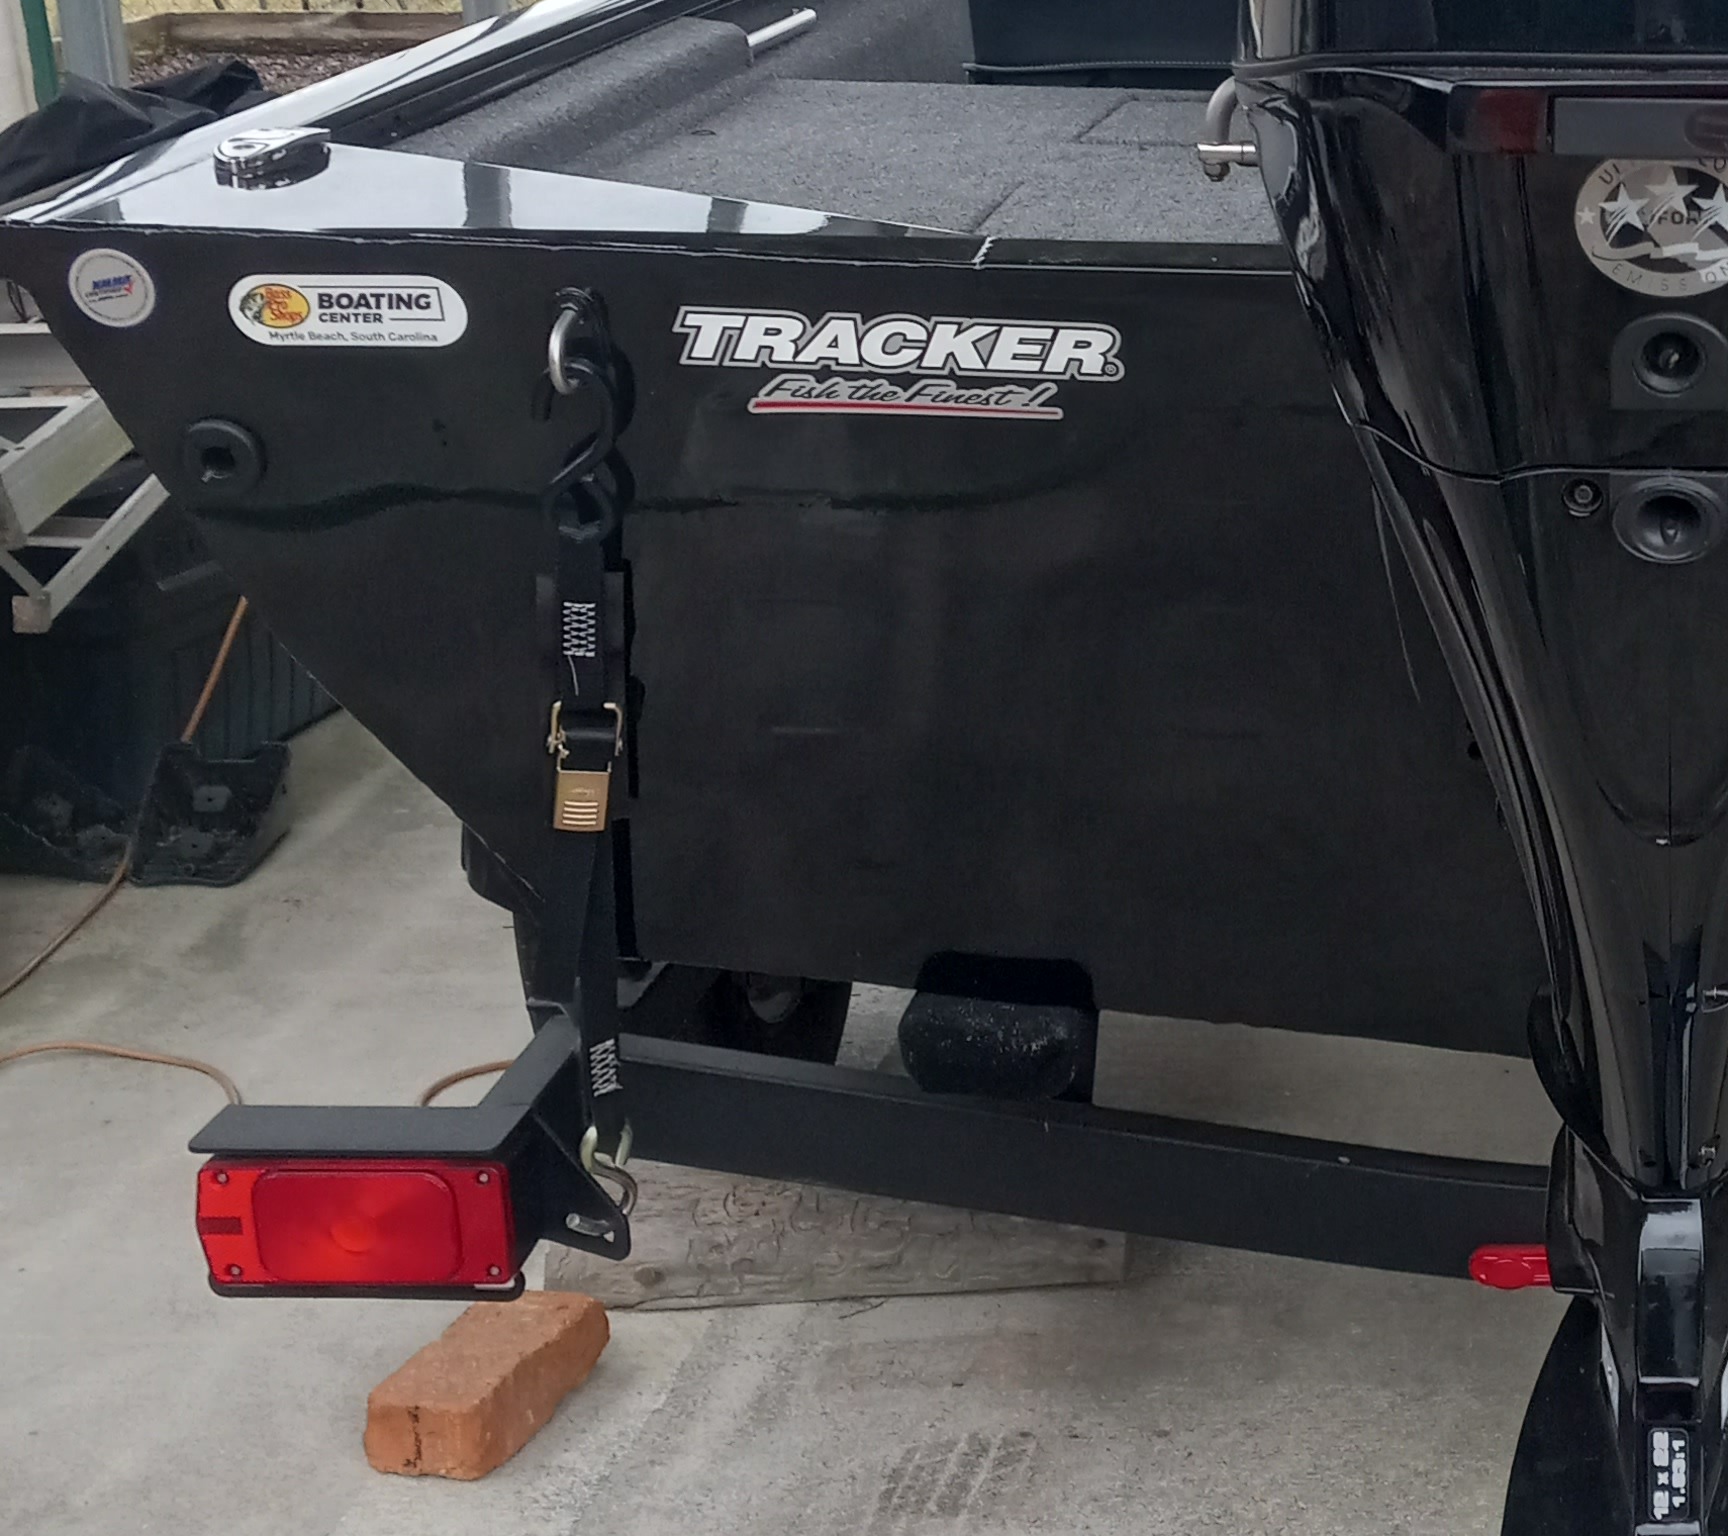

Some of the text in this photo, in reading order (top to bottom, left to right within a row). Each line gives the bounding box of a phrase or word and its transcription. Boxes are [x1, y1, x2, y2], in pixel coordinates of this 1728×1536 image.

[318, 293, 432, 310] BOATING
[319, 314, 383, 324] CENTER
[268, 331, 305, 342] Myrtle
[351, 332, 385, 341] South
[388, 332, 438, 342] Carolina
[680, 311, 1120, 377] TRACKER
[764, 377, 839, 402] Fish
[848, 378, 899, 402] the
[1653, 1490, 1670, 1521] 12
